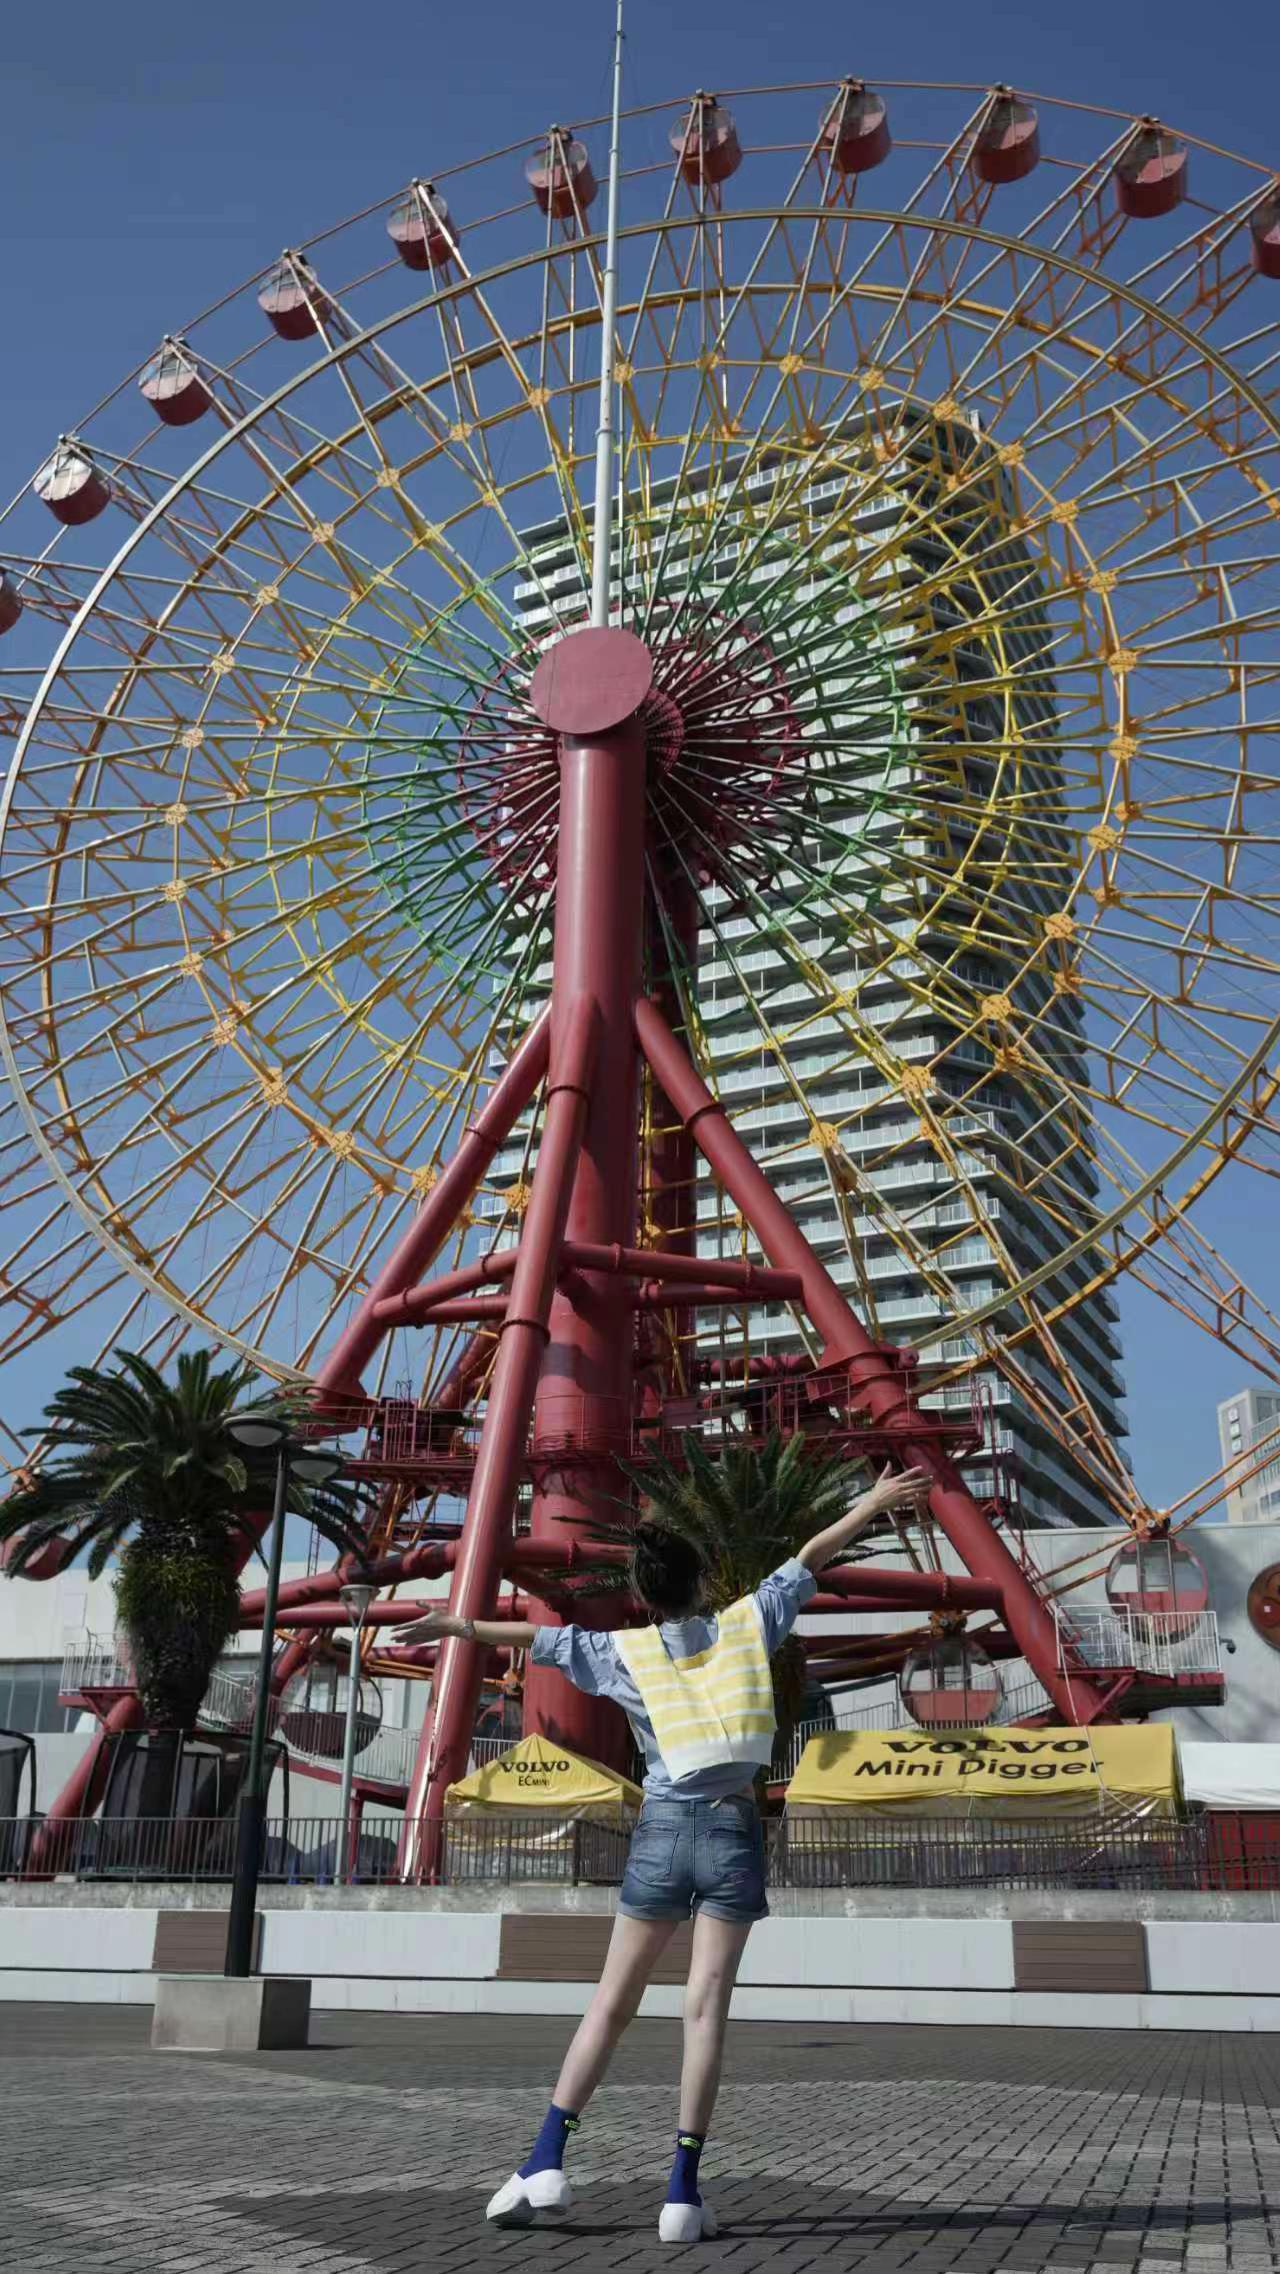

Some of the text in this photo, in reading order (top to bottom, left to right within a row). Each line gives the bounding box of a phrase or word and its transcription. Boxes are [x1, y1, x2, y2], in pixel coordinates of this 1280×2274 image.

[882, 1739, 1090, 1754] VOLVO
[500, 1760, 570, 1773] VOLVO
[854, 1758, 1104, 1780] Mini Digger
